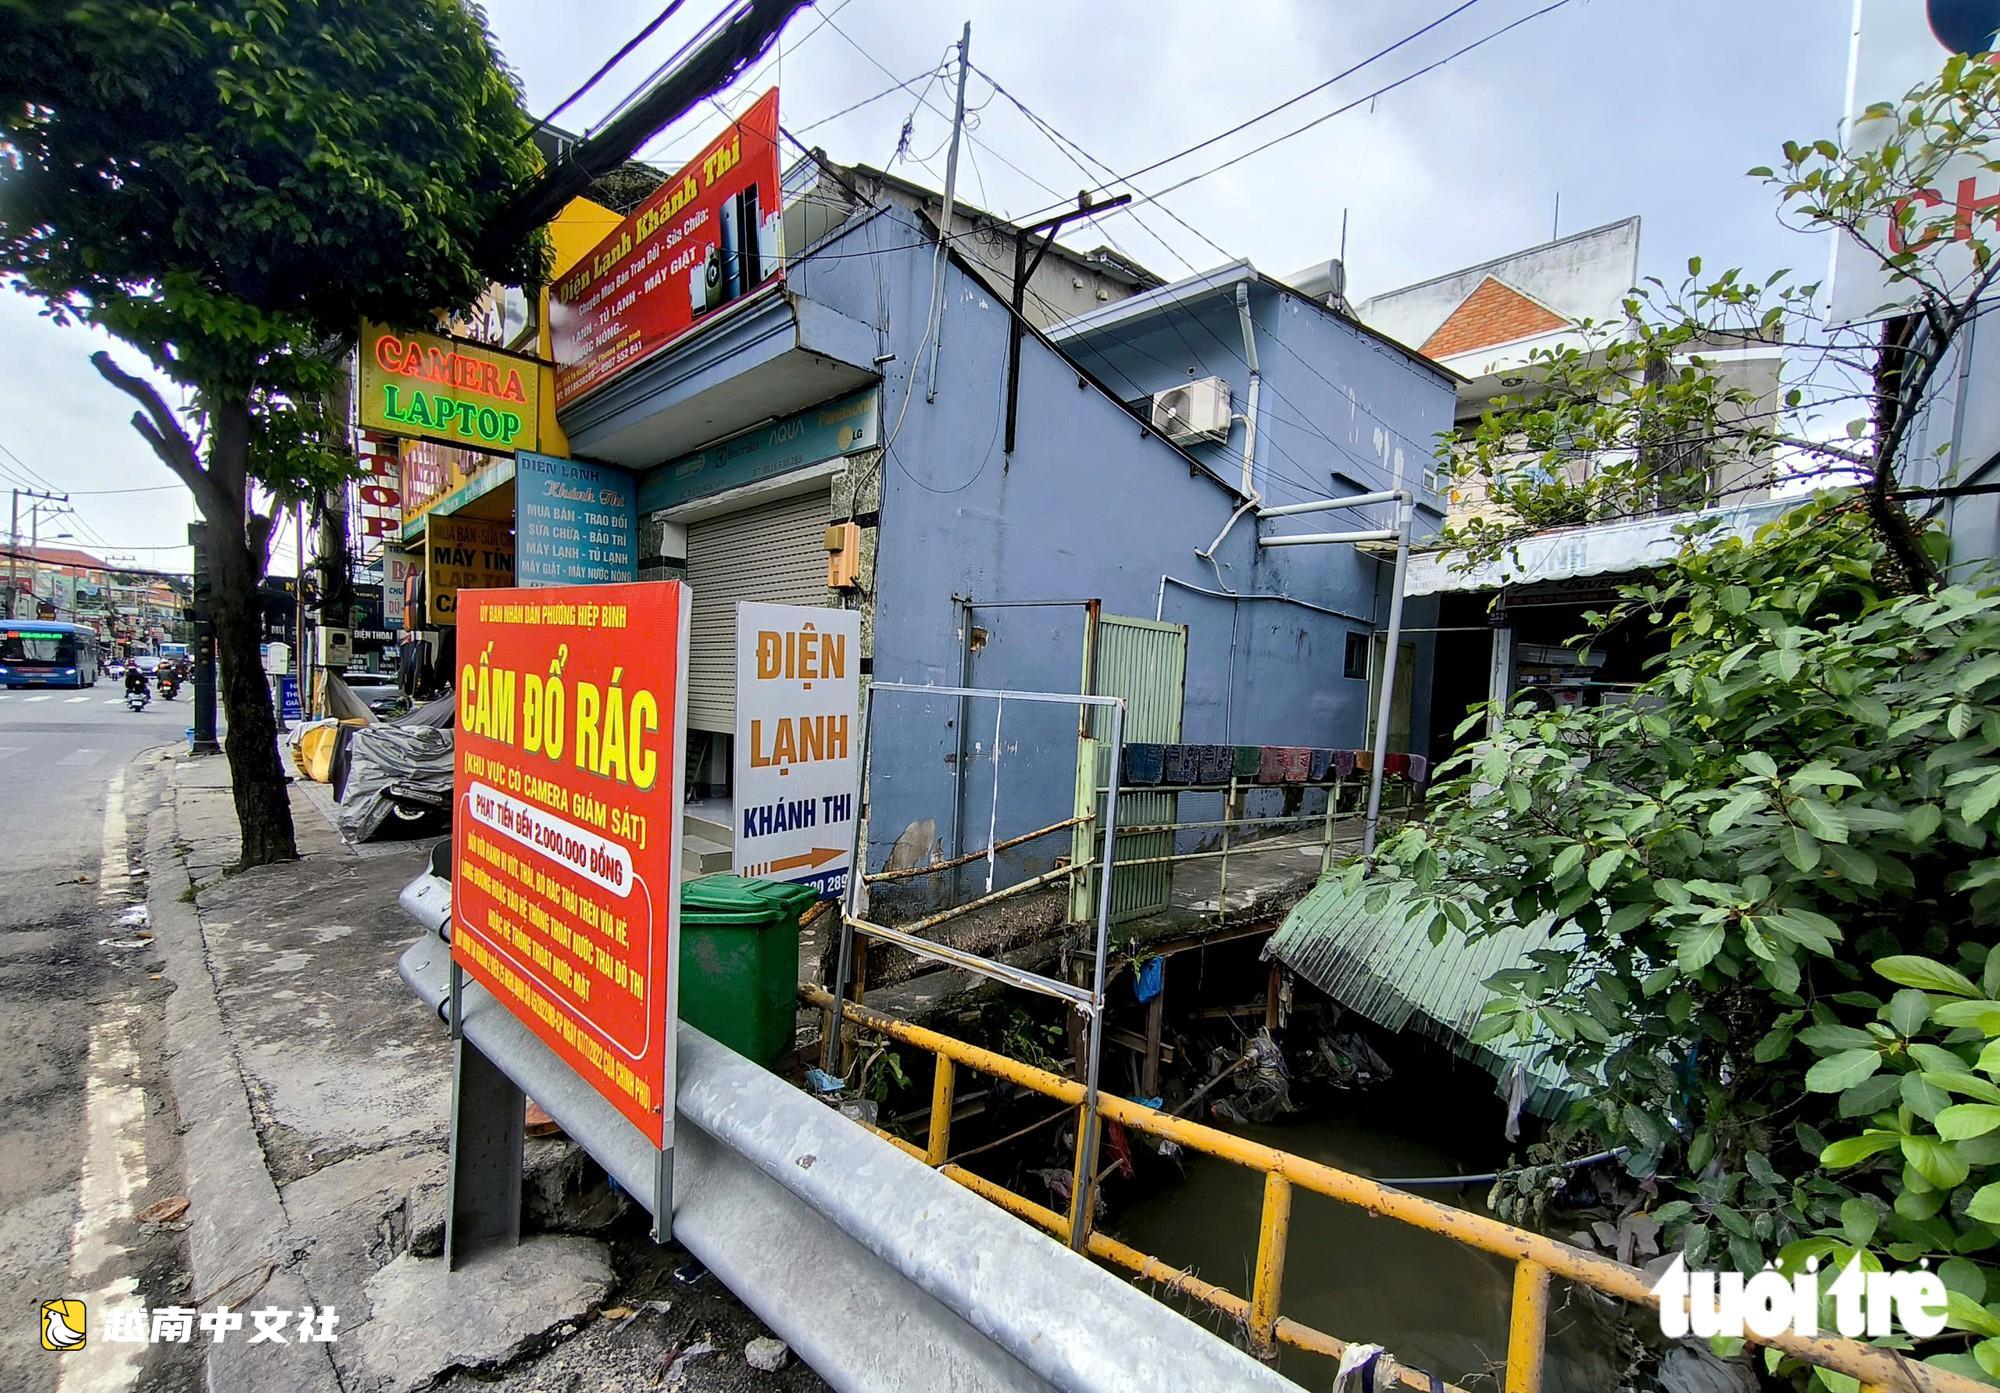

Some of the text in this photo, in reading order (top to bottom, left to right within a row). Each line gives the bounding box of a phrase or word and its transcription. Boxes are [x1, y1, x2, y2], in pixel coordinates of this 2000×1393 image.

[594, 233, 632, 279] Lạnh
[636, 174, 698, 245] Khánh
[704, 134, 740, 187] Thi
[599, 308, 610, 325] TỦ
[611, 290, 636, 317] LẠNH
[644, 266, 667, 294] MÁY
[670, 246, 697, 275] GIẶT
[601, 280, 615, 302] Mua
[616, 268, 630, 289] Bán
[631, 257, 645, 278] Trao
[376, 335, 527, 404] CAMERA
[384, 384, 521, 443] LAPTOP
[769, 420, 805, 446] AQUA
[852, 428, 863, 441] LG
[359, 430, 401, 538] TOP
[527, 504, 551, 519] MUA
[553, 506, 575, 521] BÁN
[584, 512, 609, 528] TRAO
[528, 521, 550, 537] SỬA
[552, 526, 580, 541] CHỮA
[589, 529, 609, 545] BẢO
[434, 543, 476, 568] MÁY
[521, 560, 541, 574] MÁY
[542, 562, 561, 578] GIẶT
[568, 564, 586, 578] MÁY
[526, 541, 628, 566] MÁY LẠNH TỦ LẠNH
[488, 604, 502, 622] BAN
[503, 601, 523, 623] NHÂN
[524, 601, 540, 624] DÂN
[541, 601, 576, 626] PHƯỜNG
[577, 601, 599, 631] HIỆP
[601, 600, 627, 629] BÌNH
[755, 622, 846, 690] ĐIỆN
[460, 640, 658, 792] CẤM ĐỔ RÁC
[751, 715, 848, 776] LẠNH
[486, 759, 506, 787] VỰC
[507, 764, 521, 793] CÓ
[523, 773, 569, 813] CAMERA
[572, 791, 606, 830] GIÁM
[743, 793, 851, 839] KHÁNH THI
[476, 793, 494, 821] PHẠT
[515, 806, 533, 841] ĐẾN
[534, 821, 586, 869] 2.000.000
[589, 841, 623, 887] ĐỒNG
[535, 867, 545, 896] BỎ
[545, 875, 560, 906] RÁC
[561, 883, 578, 917] THẢI
[578, 895, 599, 930] TRÊN
[826, 873, 848, 893] 289
[531, 939, 552, 974] THOÁT
[552, 954, 572, 989] NƯỚC
[573, 969, 590, 1005] MẶT
[549, 915, 572, 951] THOÁT
[572, 930, 593, 966] NƯỚC
[594, 944, 613, 981] THẢI
[614, 958, 628, 990] ĐÔ
[628, 967, 644, 1007] THỊ
